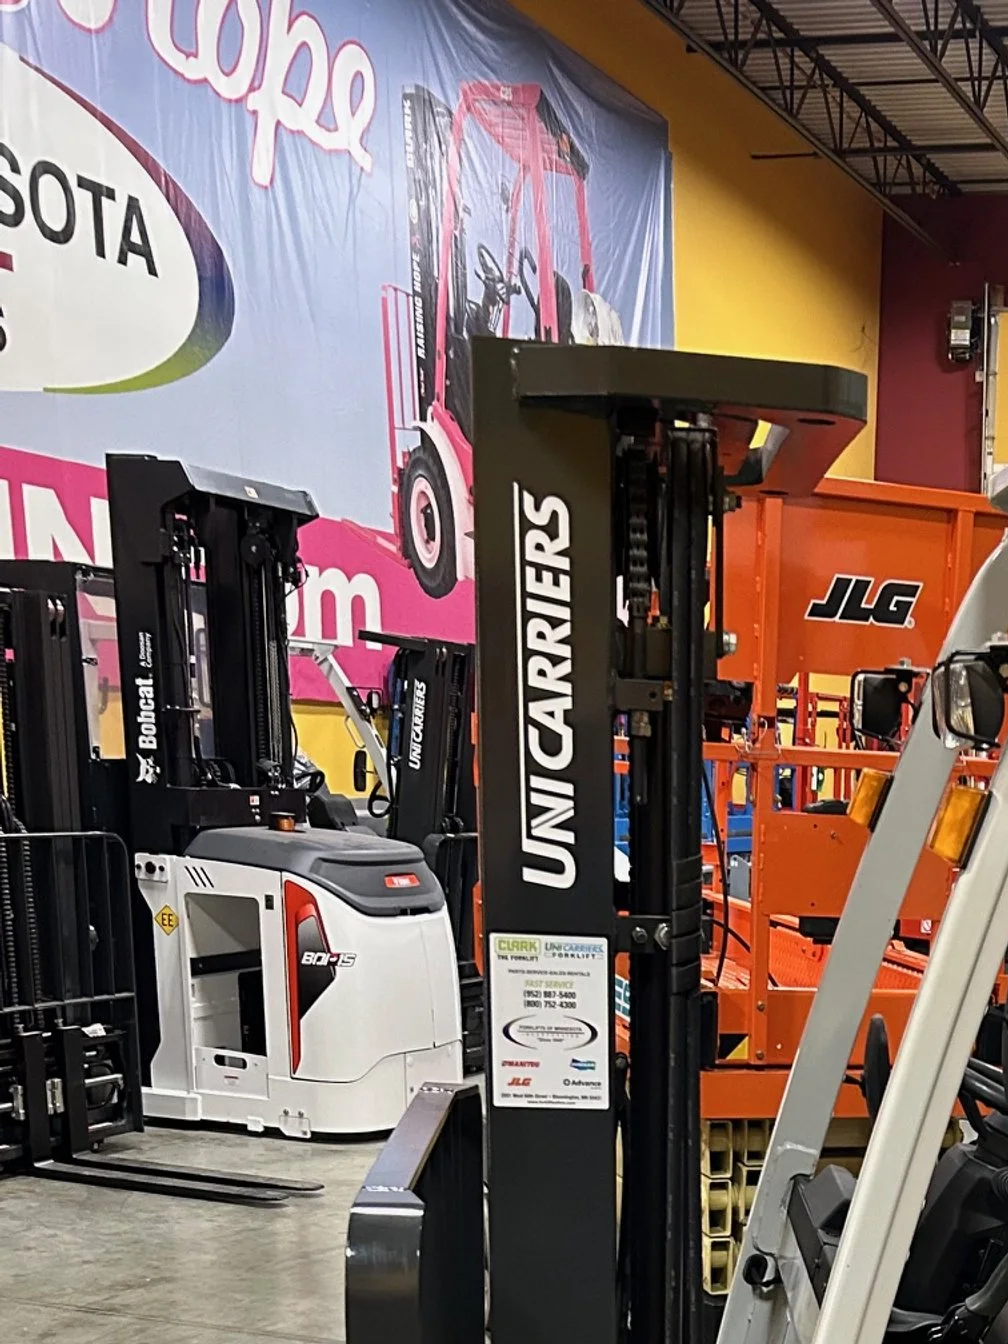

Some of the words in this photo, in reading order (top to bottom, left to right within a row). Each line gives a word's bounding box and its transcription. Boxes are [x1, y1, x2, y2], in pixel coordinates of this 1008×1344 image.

[804, 573, 923, 628] JLG
[513, 482, 577, 890] UNICARRIERS
[135, 676, 158, 750] Bobcat
[409, 679, 427, 770] UNICARRIERS
[161, 912, 174, 927] EE
[497, 939, 538, 952] CLARK
[524, 980, 543, 988] FAST
[545, 981, 575, 989] SERVICE
[507, 1077, 532, 1087] JLG
